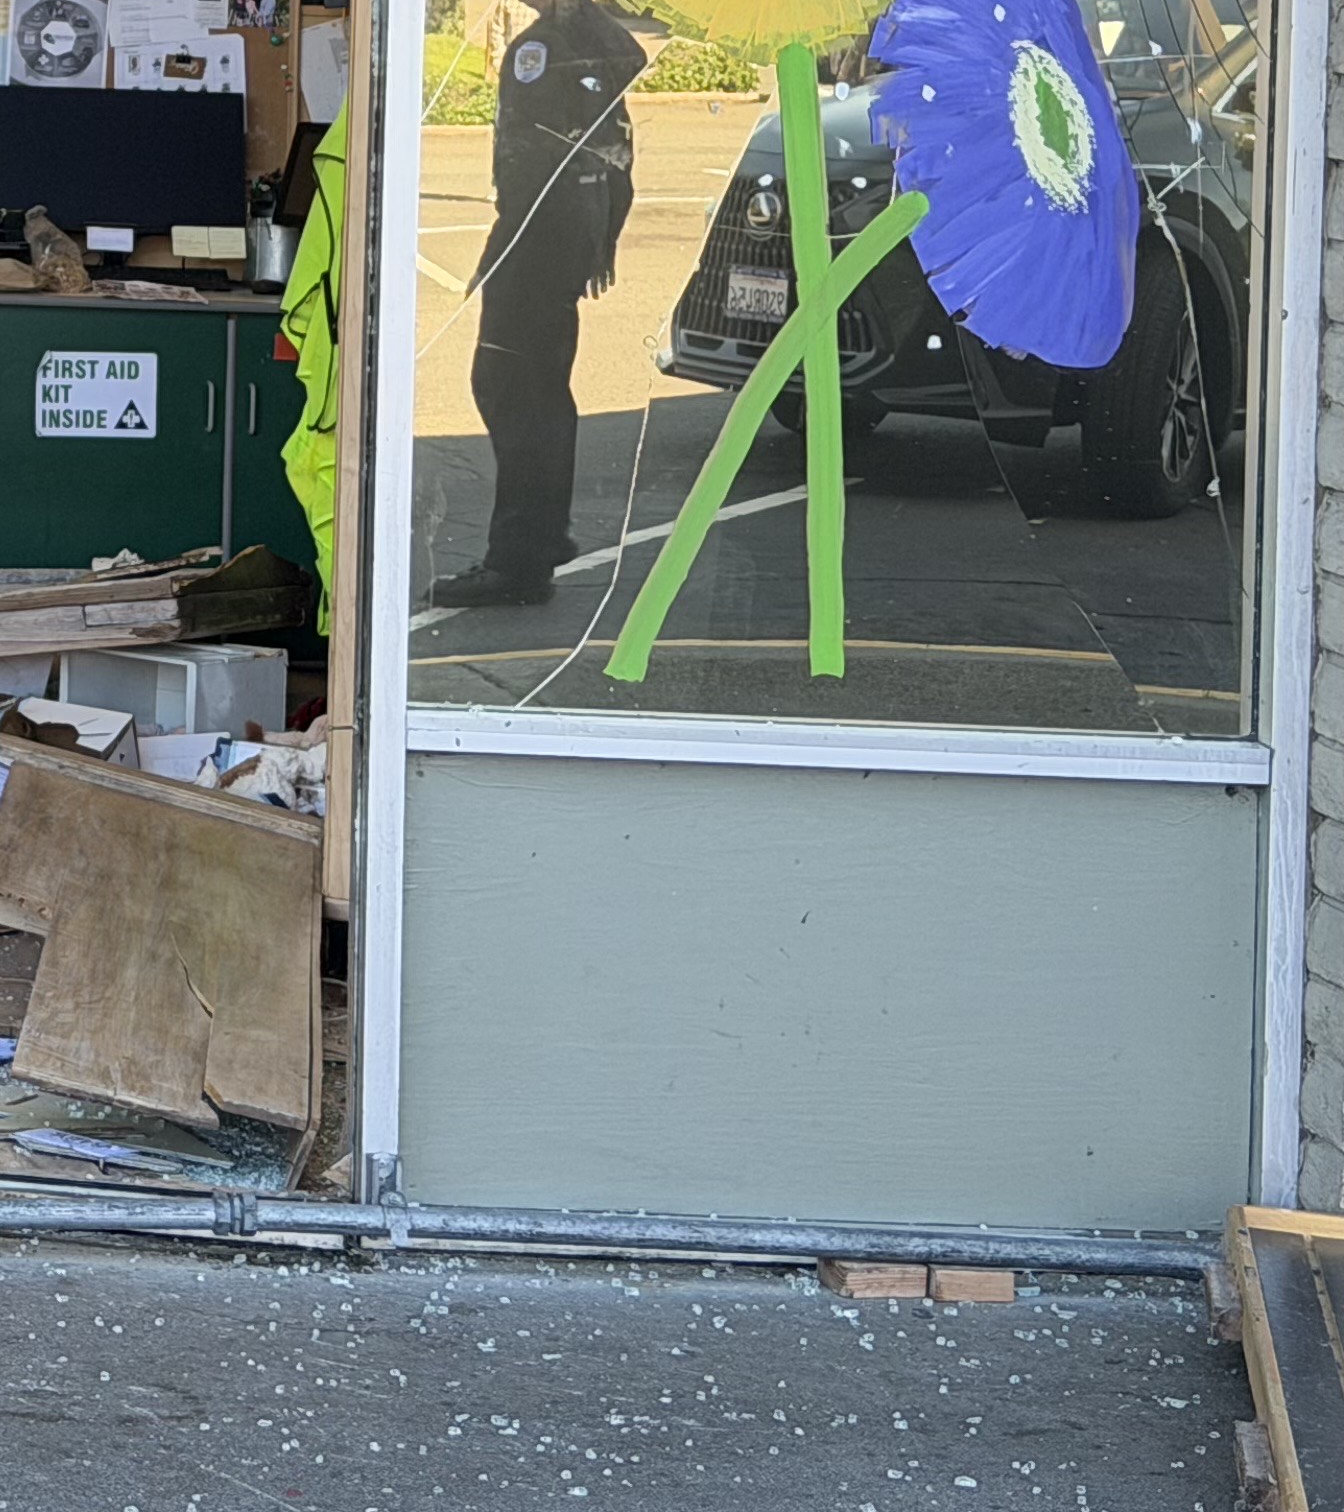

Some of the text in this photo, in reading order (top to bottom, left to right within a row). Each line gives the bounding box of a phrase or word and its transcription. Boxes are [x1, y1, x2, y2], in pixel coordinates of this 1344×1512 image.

[40, 359, 141, 381] FIRST AID
[40, 384, 73, 404] KIT
[40, 408, 109, 430] INSIDE
